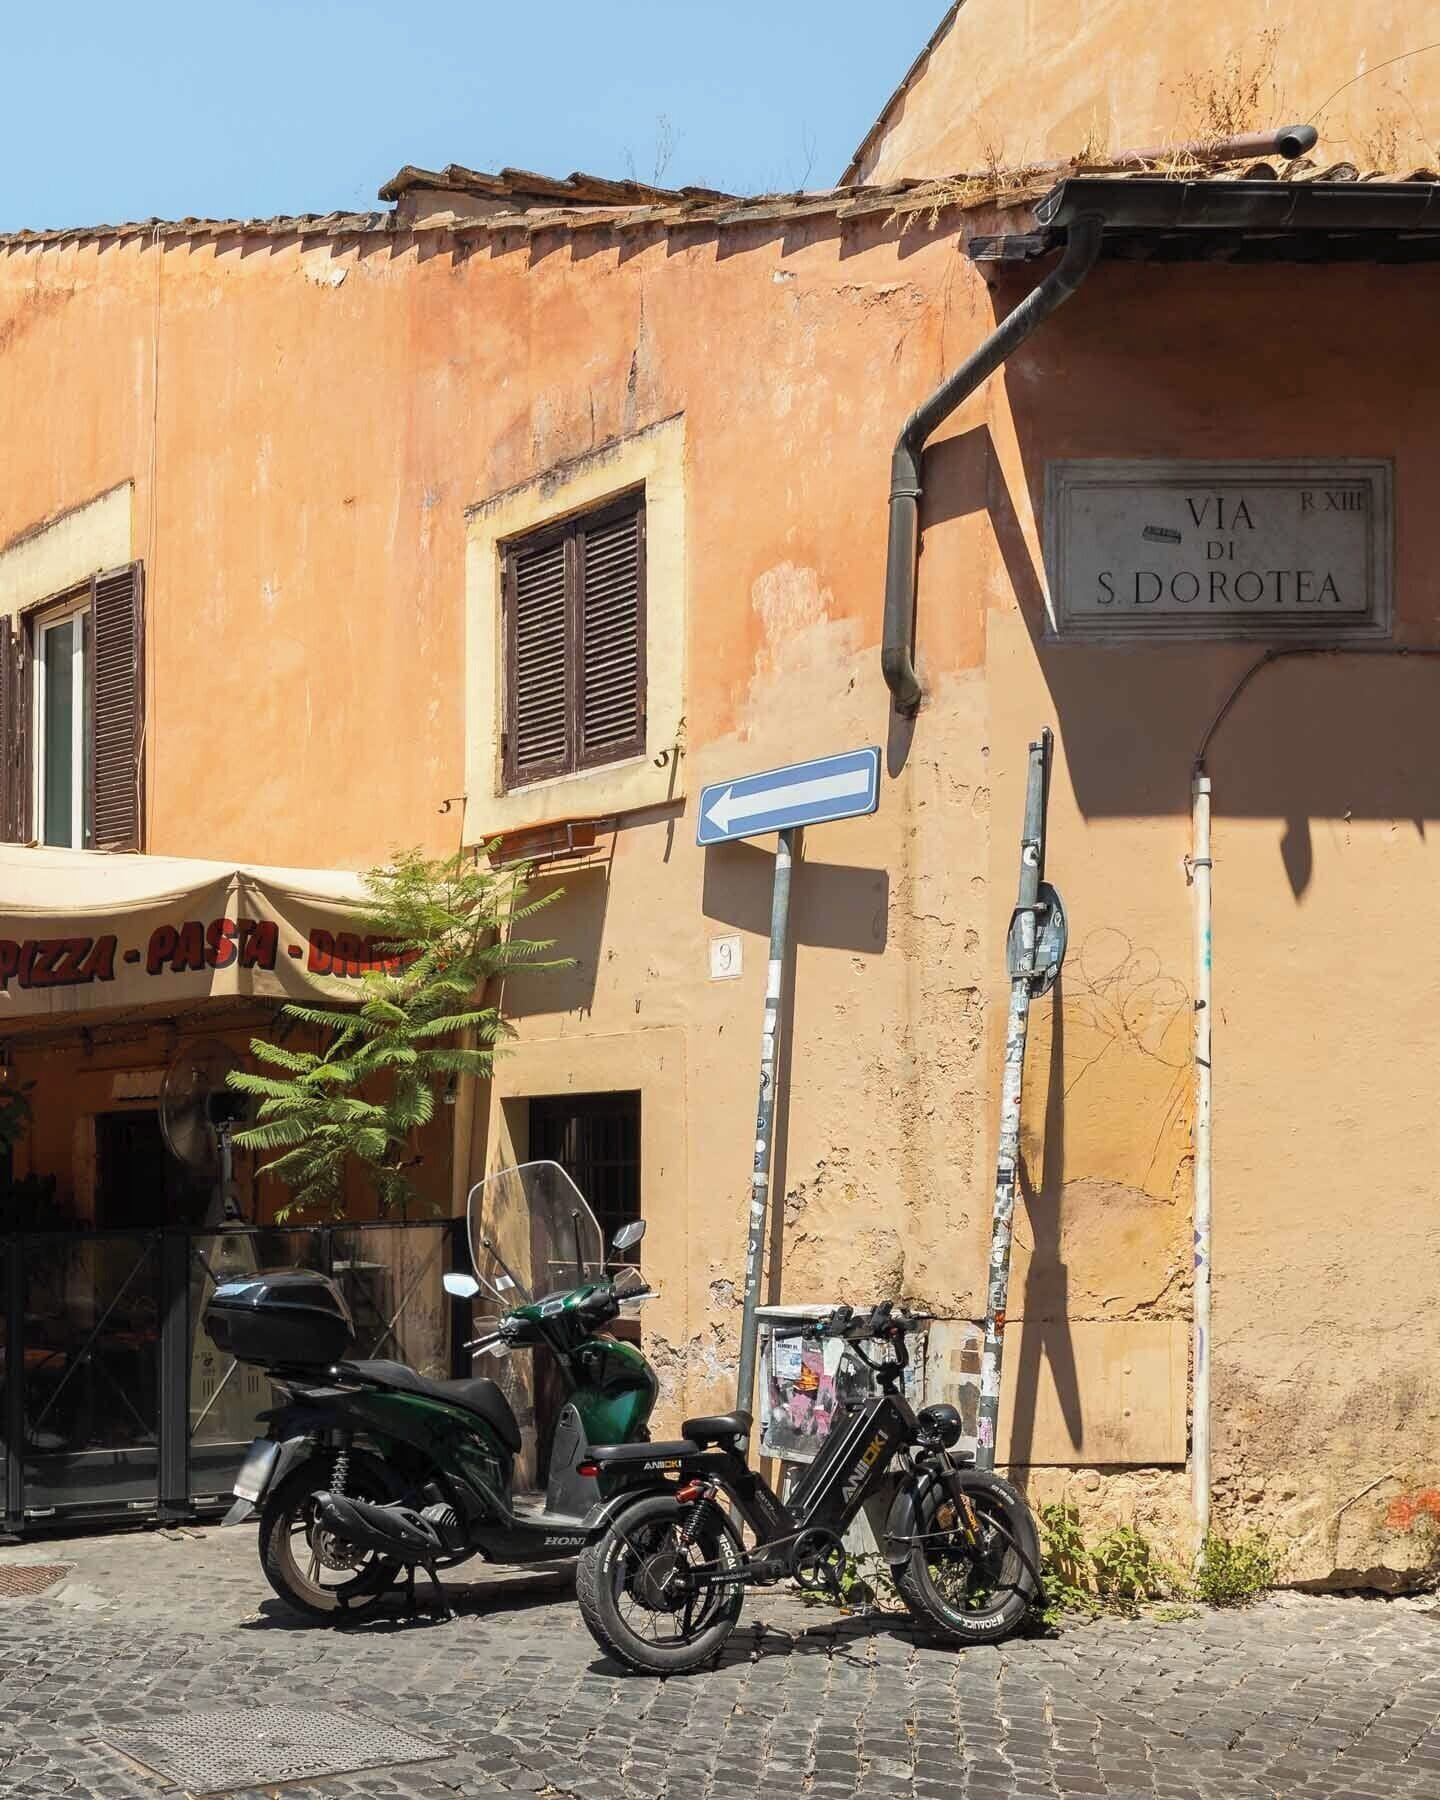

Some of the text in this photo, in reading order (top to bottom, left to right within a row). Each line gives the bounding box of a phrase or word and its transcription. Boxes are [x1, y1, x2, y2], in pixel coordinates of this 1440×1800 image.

[1185, 497, 1256, 530] VIA
[1324, 491, 1362, 511] XIII
[1206, 541, 1234, 560] DI
[1134, 571, 1341, 603] DOROTEA
[146, 918, 280, 976] PASTA
[719, 943, 732, 970] 9
